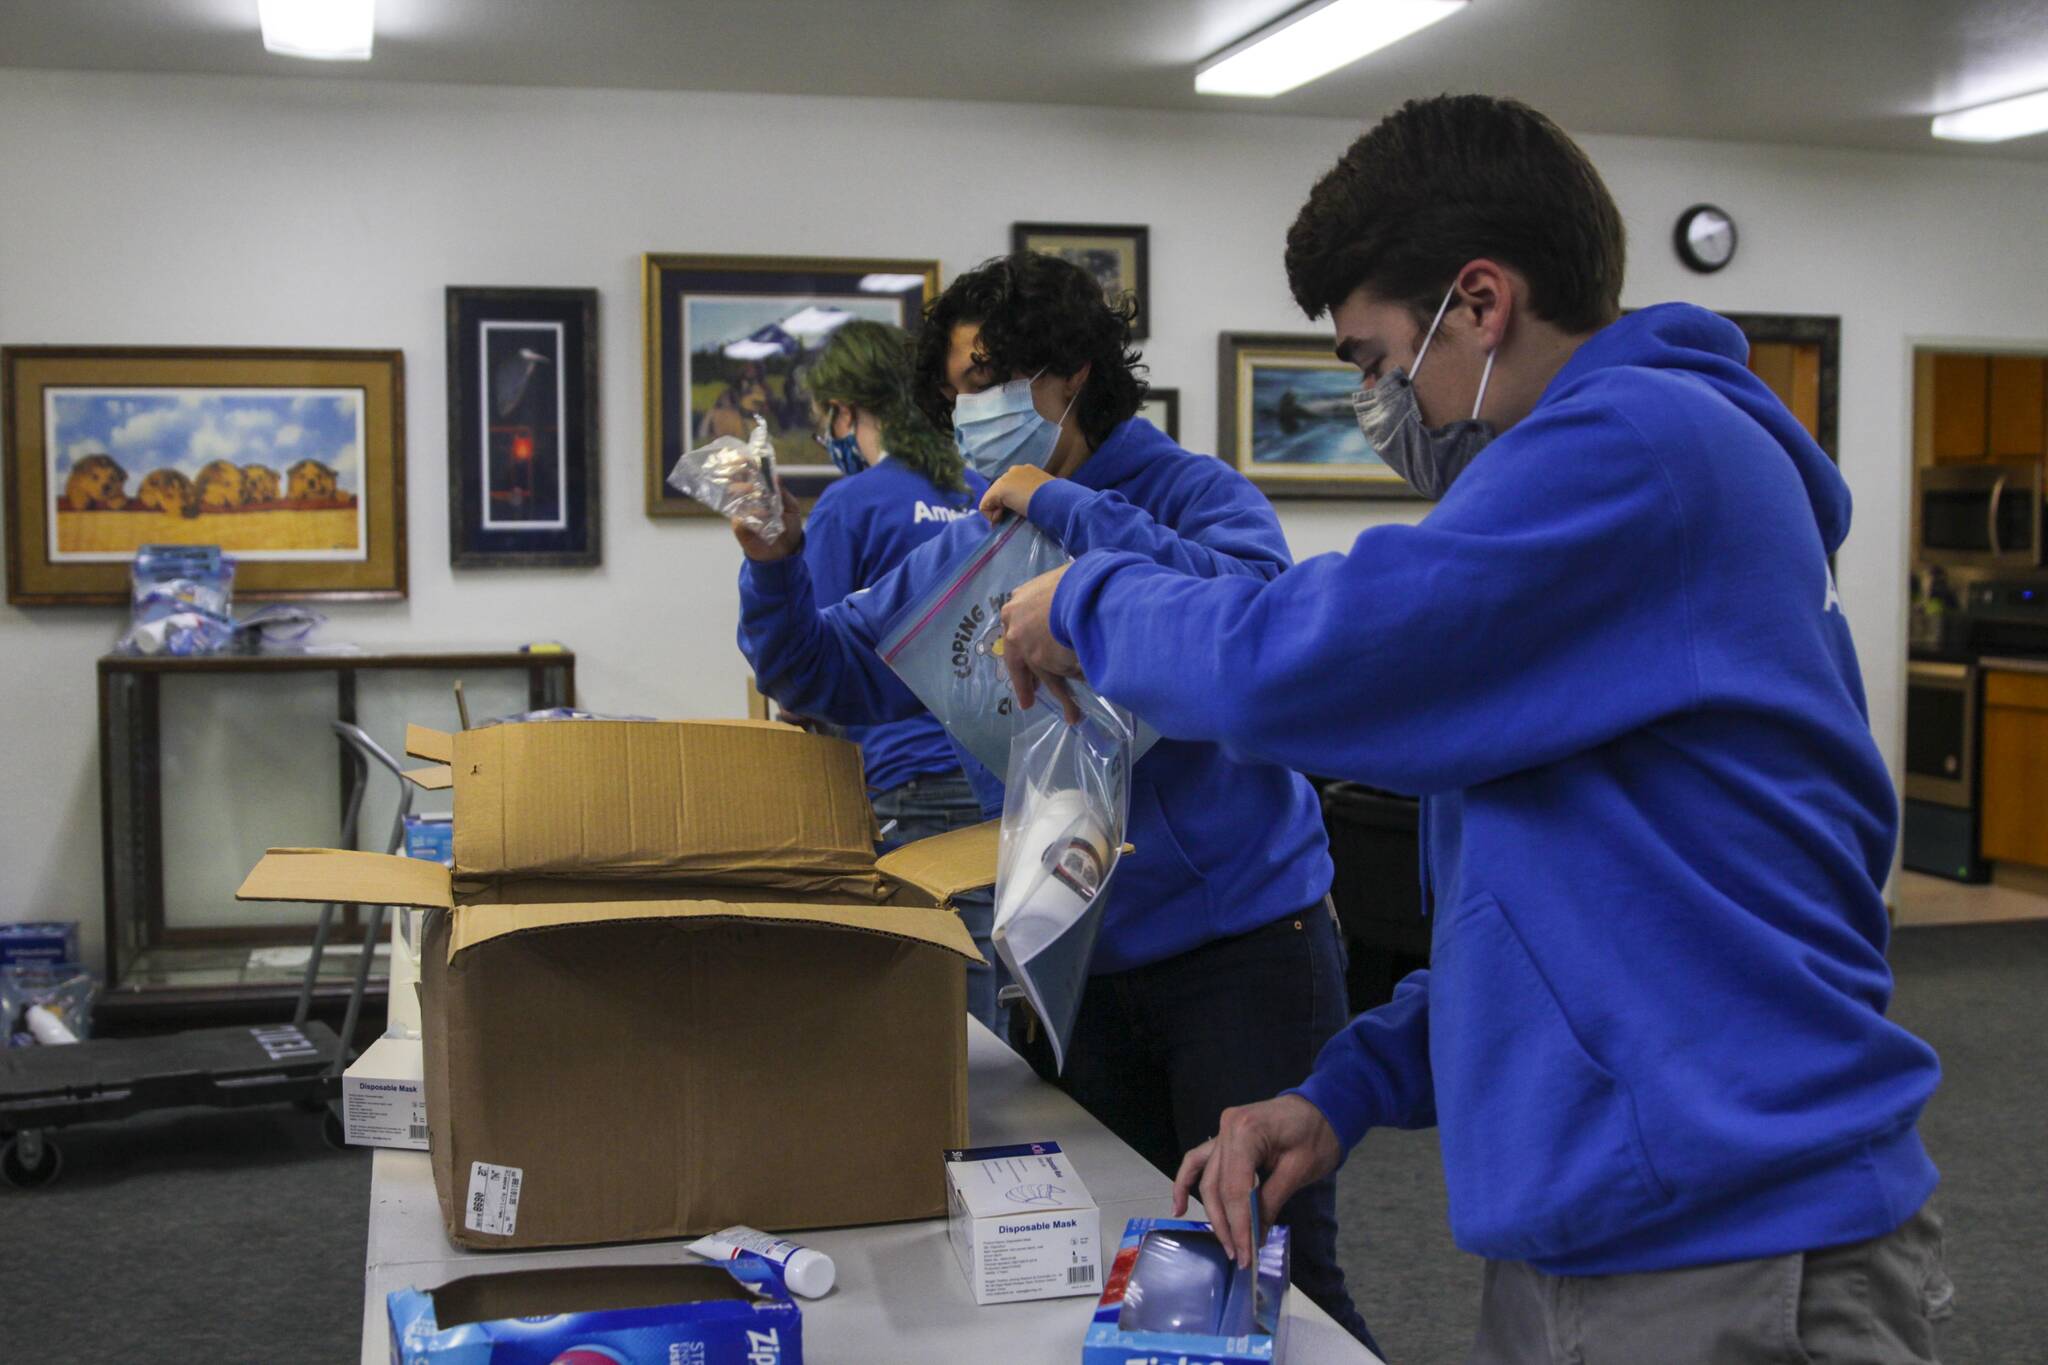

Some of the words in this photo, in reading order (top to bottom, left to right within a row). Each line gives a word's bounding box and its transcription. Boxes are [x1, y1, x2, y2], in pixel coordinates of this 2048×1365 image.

[359, 1082, 397, 1092] Disposable
[998, 1222, 1050, 1234] Disposable
[1052, 1219, 1077, 1229] Mask
